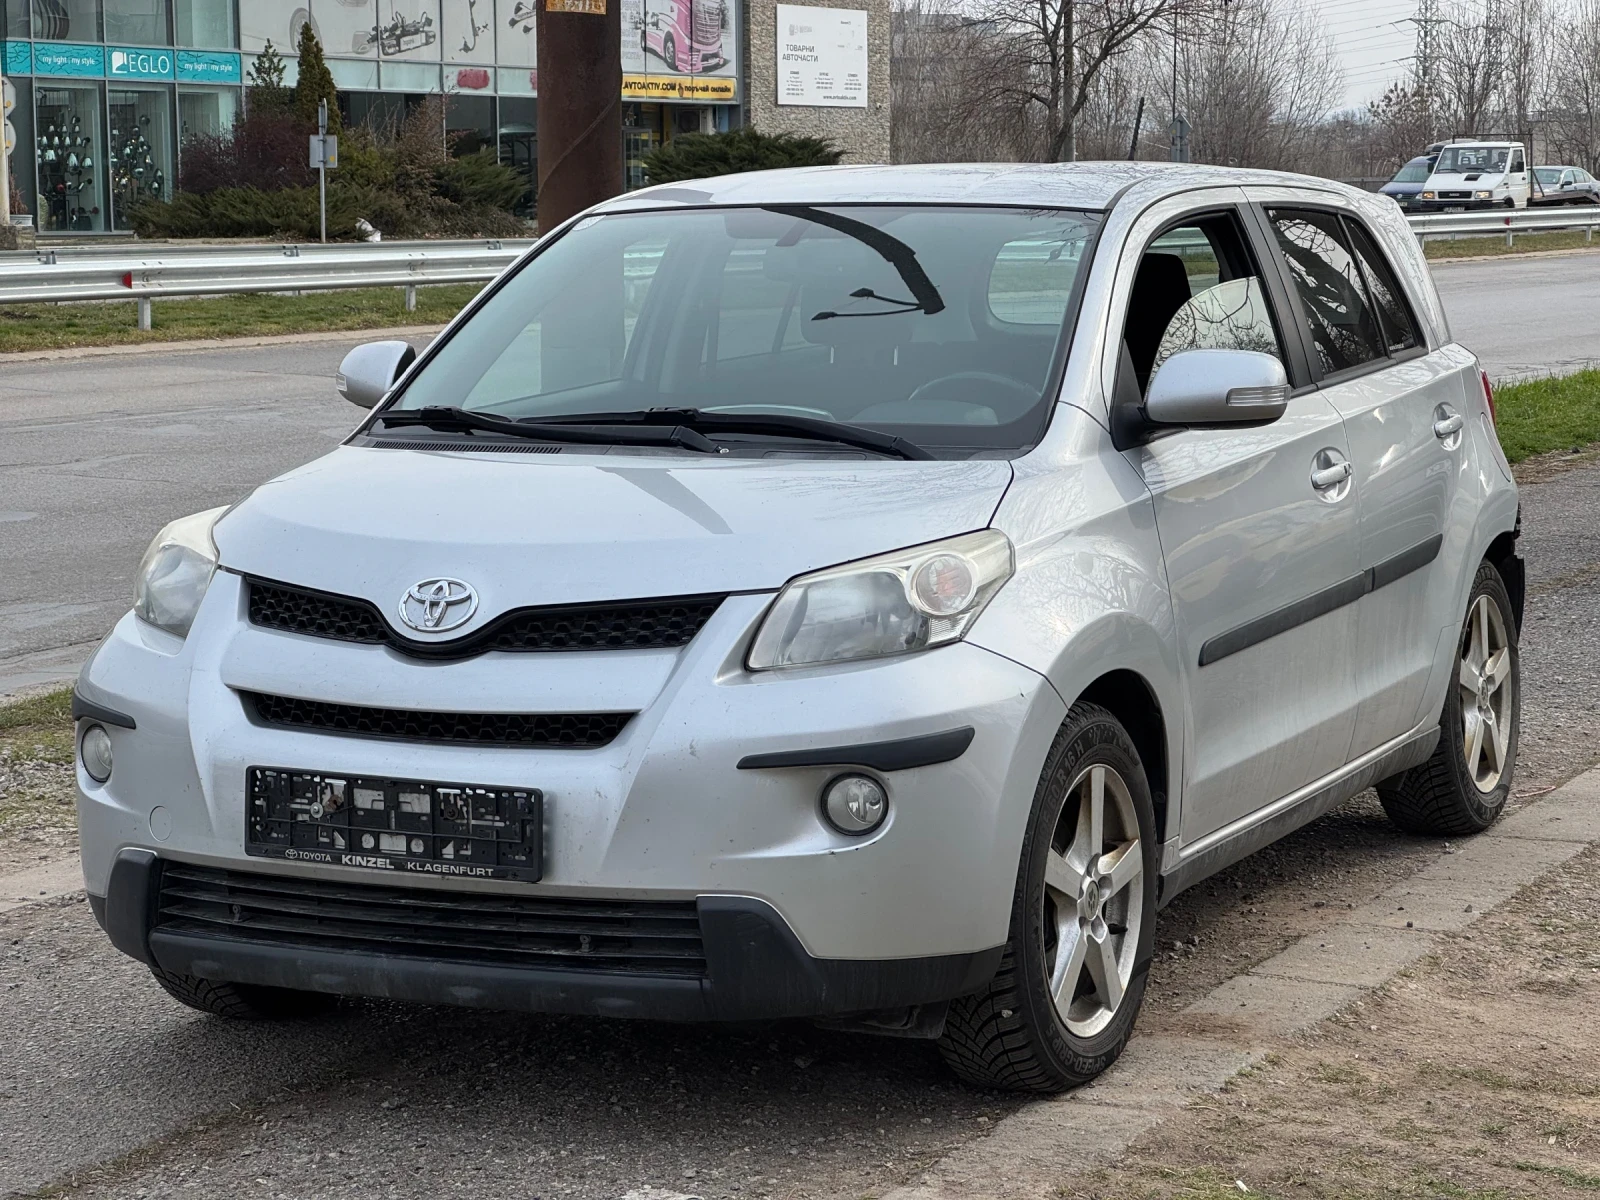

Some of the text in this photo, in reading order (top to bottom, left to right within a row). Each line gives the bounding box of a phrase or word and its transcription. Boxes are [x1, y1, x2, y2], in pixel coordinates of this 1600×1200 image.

[786, 44, 815, 53] ТОВАРНИ
[42, 55, 95, 66] my light my style
[782, 53, 819, 62] АВТОЧАСТИ
[129, 54, 170, 74] EGLO
[184, 62, 233, 73] my light my style
[684, 85, 731, 94] поръчай онлайн
[1056, 769, 1067, 784] R
[1064, 750, 1076, 770] 16
[1074, 739, 1085, 755] H
[299, 851, 494, 877] TOYOTA KINZEL KLAGENFURT
[1051, 1036, 1107, 1074] SPEED-GRIP
